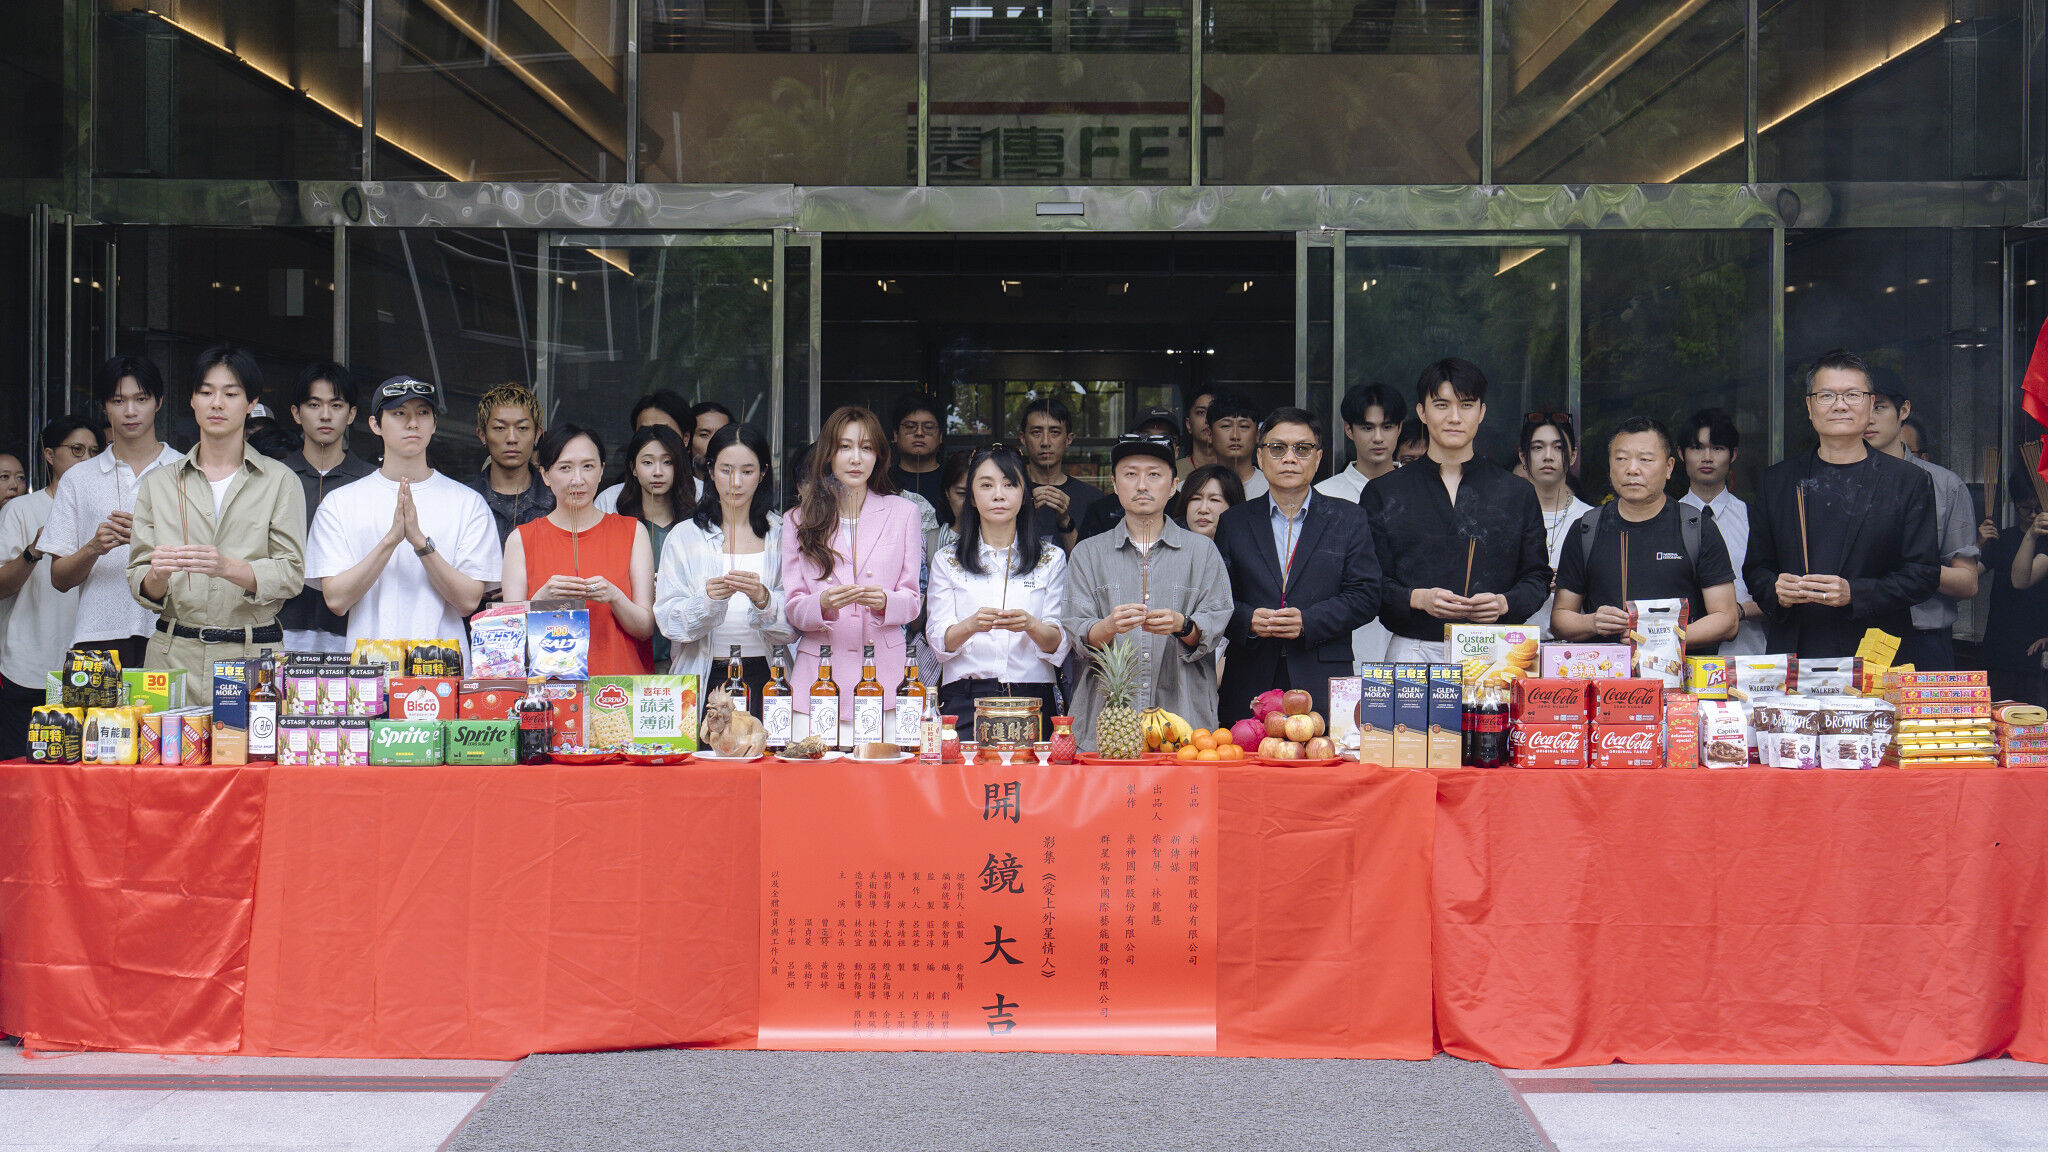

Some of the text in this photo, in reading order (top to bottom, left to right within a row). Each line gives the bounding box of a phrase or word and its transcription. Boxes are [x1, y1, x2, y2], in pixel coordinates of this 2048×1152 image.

[1080, 126, 1225, 178] FET
[552, 626, 569, 637] 100
[1457, 633, 1495, 643] Custard
[540, 639, 577, 650] SALT
[1463, 643, 1488, 653] Cake
[148, 675, 167, 687] 30
[407, 700, 437, 712] Bisco
[640, 698, 675, 713] 蔬菜
[640, 716, 675, 730] 薄餅
[1825, 714, 1869, 729] BROWNIE
[29, 729, 62, 742] 康貝特
[100, 726, 131, 739] 有能量
[377, 726, 431, 748] Sprite
[454, 725, 507, 746] Sprite
[1528, 731, 1583, 750] Coca-Cola
[1601, 731, 1656, 750] Coca-Cola
[1152, 784, 1163, 821] 出品人
[1189, 785, 1199, 808] 出品
[978, 781, 1025, 1037] 開鏡大吉
